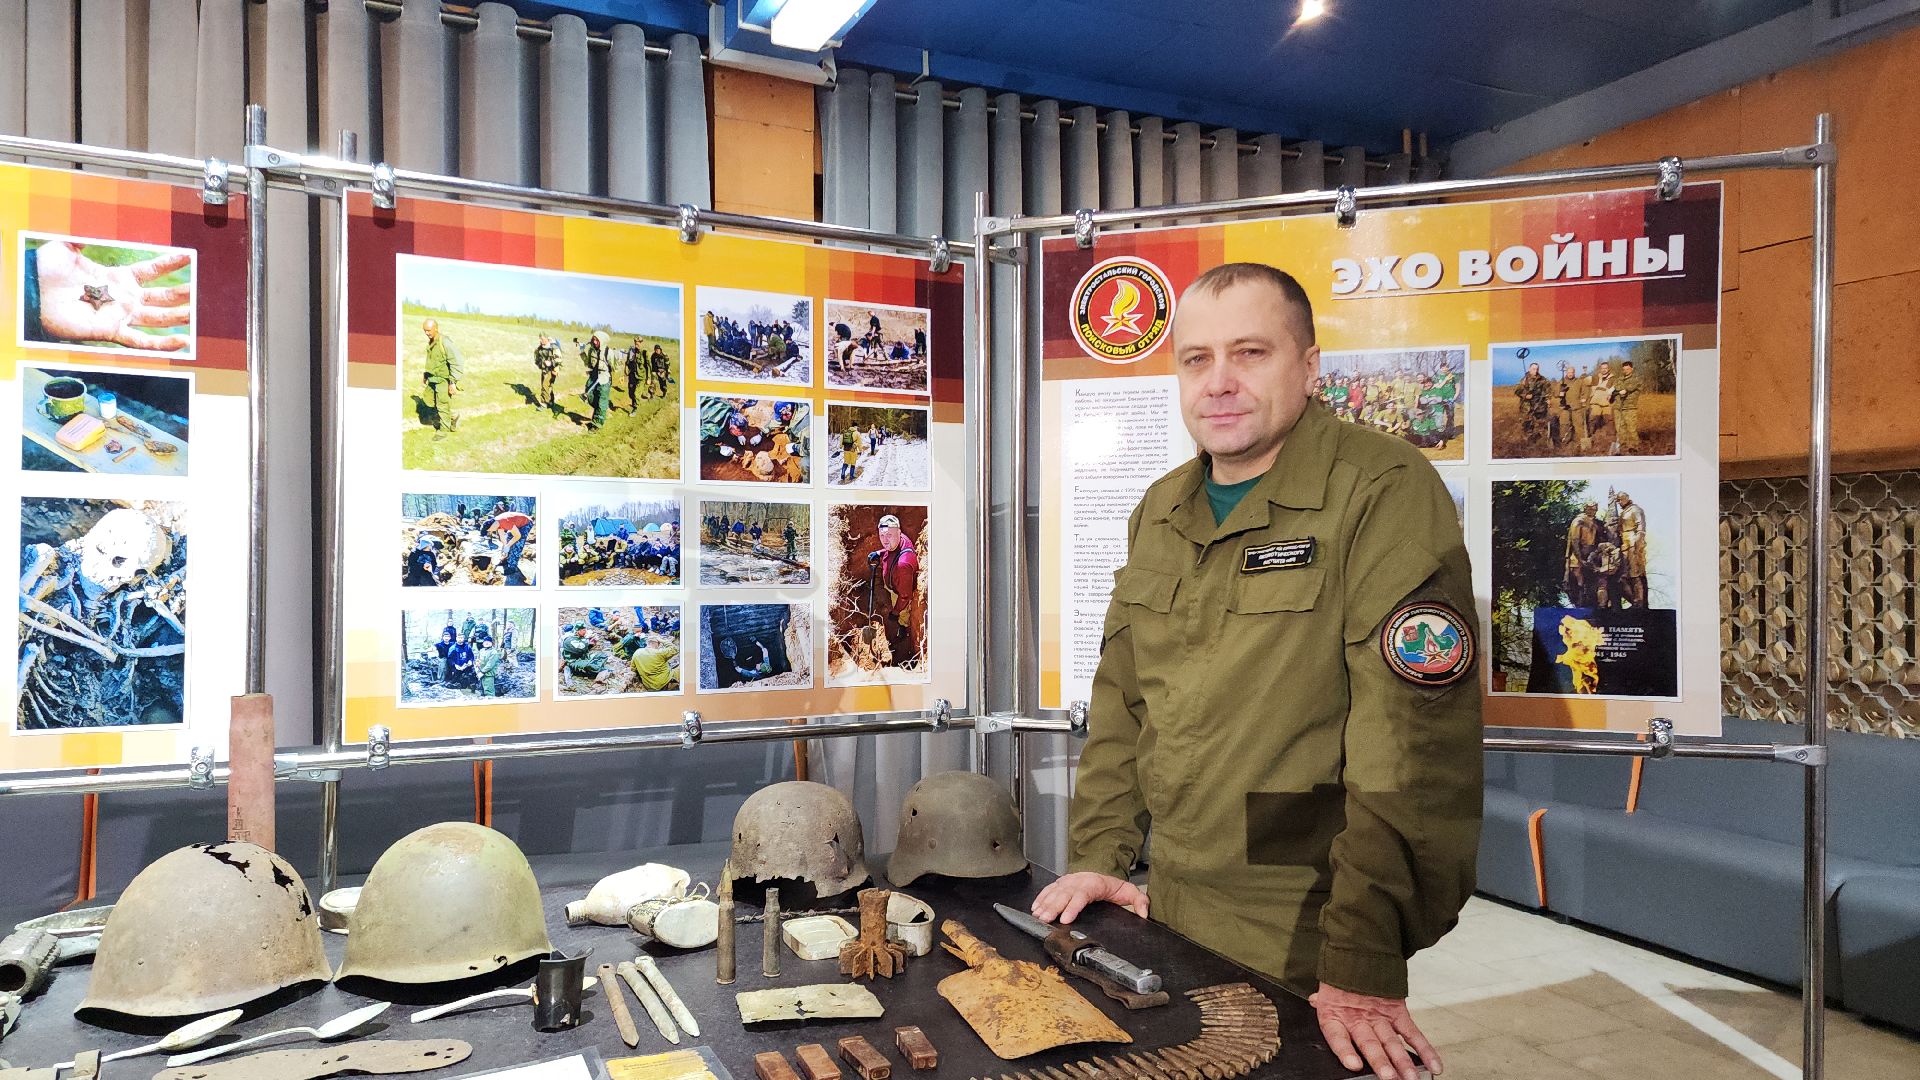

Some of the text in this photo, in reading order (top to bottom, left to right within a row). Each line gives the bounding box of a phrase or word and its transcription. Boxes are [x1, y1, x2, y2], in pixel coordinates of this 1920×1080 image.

[1331, 232, 1685, 294] ЭХО ВОЙНЫ
[1080, 266, 1165, 315] ЭЛЕКТРОСТАЛЬСКИЙ ГОРОДСКОЙ
[1081, 319, 1165, 354] ПОИСКОВЫЙ ОТРЯД
